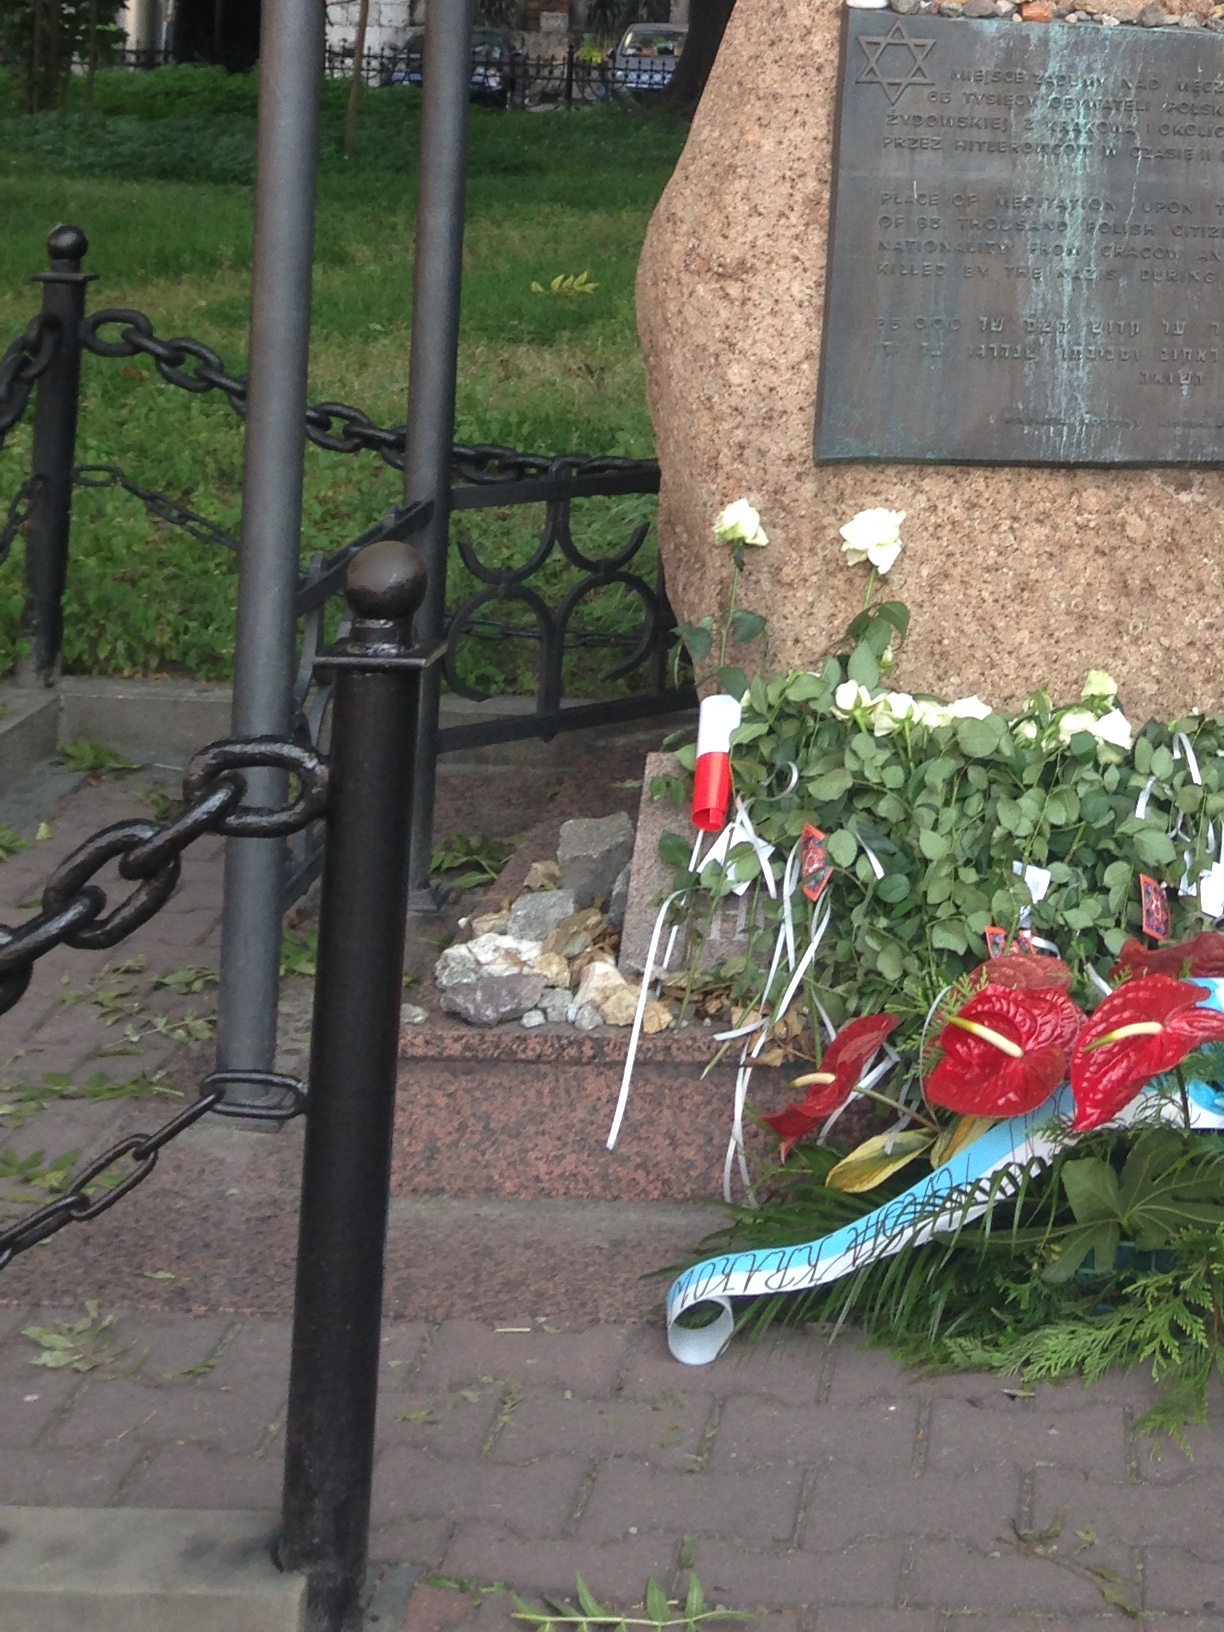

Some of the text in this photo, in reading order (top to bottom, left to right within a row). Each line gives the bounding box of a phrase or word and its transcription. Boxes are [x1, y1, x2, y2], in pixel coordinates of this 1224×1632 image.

[951, 68, 1024, 87] MIEJSCE
[1034, 73, 1107, 89] ZADUMY
[1121, 77, 1163, 92] NAD
[928, 91, 951, 104] 65
[885, 109, 1008, 132] ŻYDOWSKIEJ
[1023, 120, 1034, 131] Z
[882, 135, 943, 151] PRZEZ
[1129, 146, 1194, 162] CZASIE
[880, 191, 940, 206] PLACE
[952, 194, 978, 208] OF
[995, 195, 1116, 212] MEDITATION
[1142, 201, 1194, 215] UPON
[879, 215, 904, 229] OF
[917, 216, 942, 230] 65
[958, 217, 1068, 234] THOUSAND
[1086, 222, 1156, 237] POLISH
[877, 238, 1009, 255] NATIONALITY
[1029, 243, 1081, 258] FROM
[1101, 245, 1181, 261] CRACOW
[877, 262, 947, 277] KILLED
[965, 265, 990, 279] BY
[1005, 266, 1042, 280] THE
[1141, 270, 1216, 284] DURING
